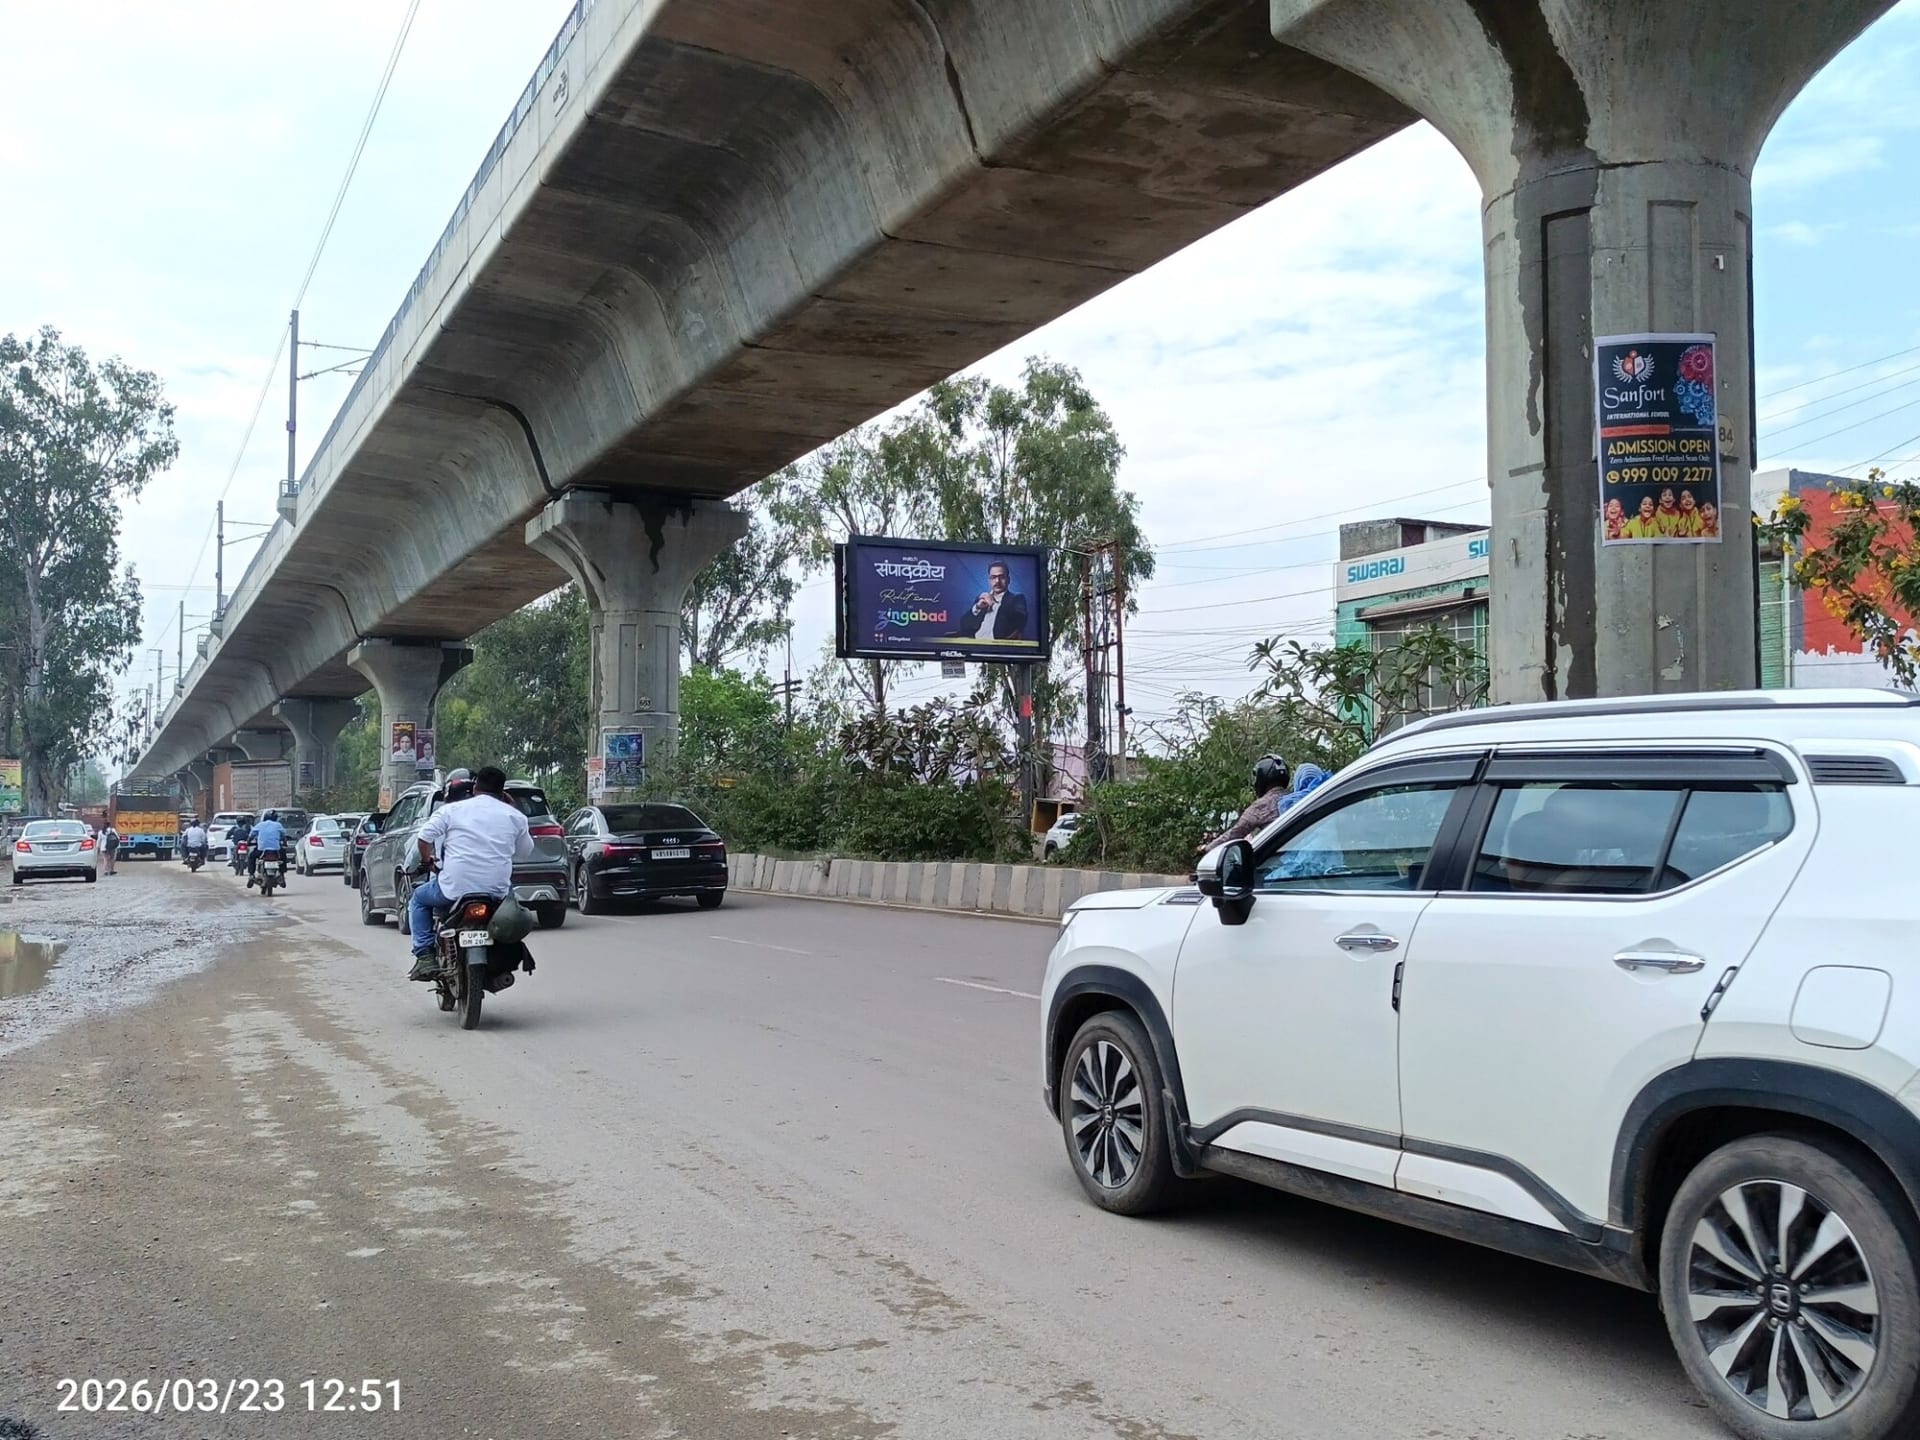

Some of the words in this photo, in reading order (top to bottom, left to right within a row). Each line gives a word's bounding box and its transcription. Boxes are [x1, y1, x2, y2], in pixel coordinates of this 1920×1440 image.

[1603, 385, 1665, 409] Sanfort
[1607, 440, 1677, 455] ADMISSION
[1679, 439, 1711, 453] OPEN
[1622, 467, 1648, 483] 999
[1652, 467, 1679, 482] 009
[1683, 467, 1713, 482] 2277
[874, 559, 946, 580] संपादकीय
